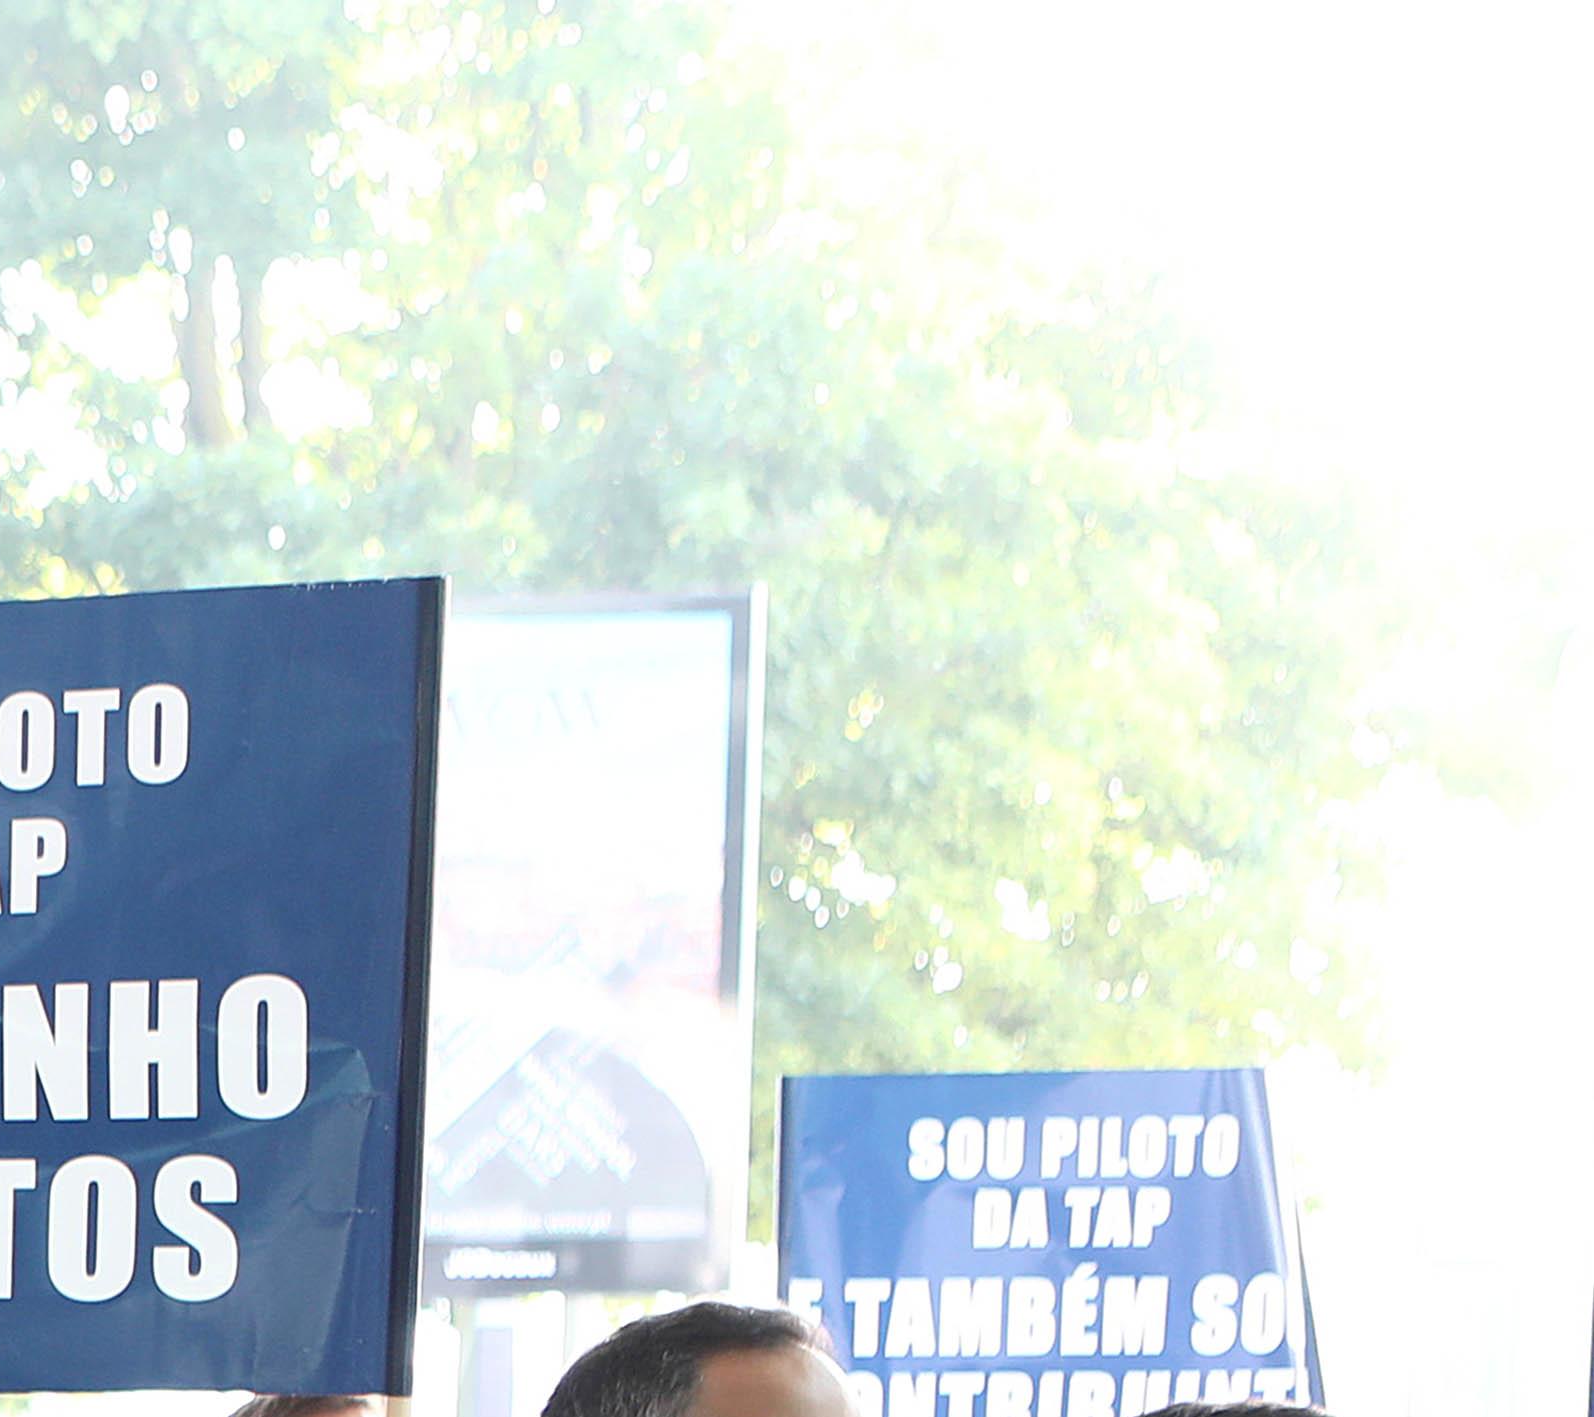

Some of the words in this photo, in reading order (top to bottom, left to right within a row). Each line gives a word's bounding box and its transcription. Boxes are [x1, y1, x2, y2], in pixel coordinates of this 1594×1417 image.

[907, 1117, 1026, 1180] SOU
[1040, 1113, 1241, 1179] PILOTO
[972, 1187, 1049, 1250] DA
[1064, 1186, 1172, 1248] TAP
[844, 1263, 1169, 1358] TAMBÉM
[1190, 1272, 1302, 1356] SO
